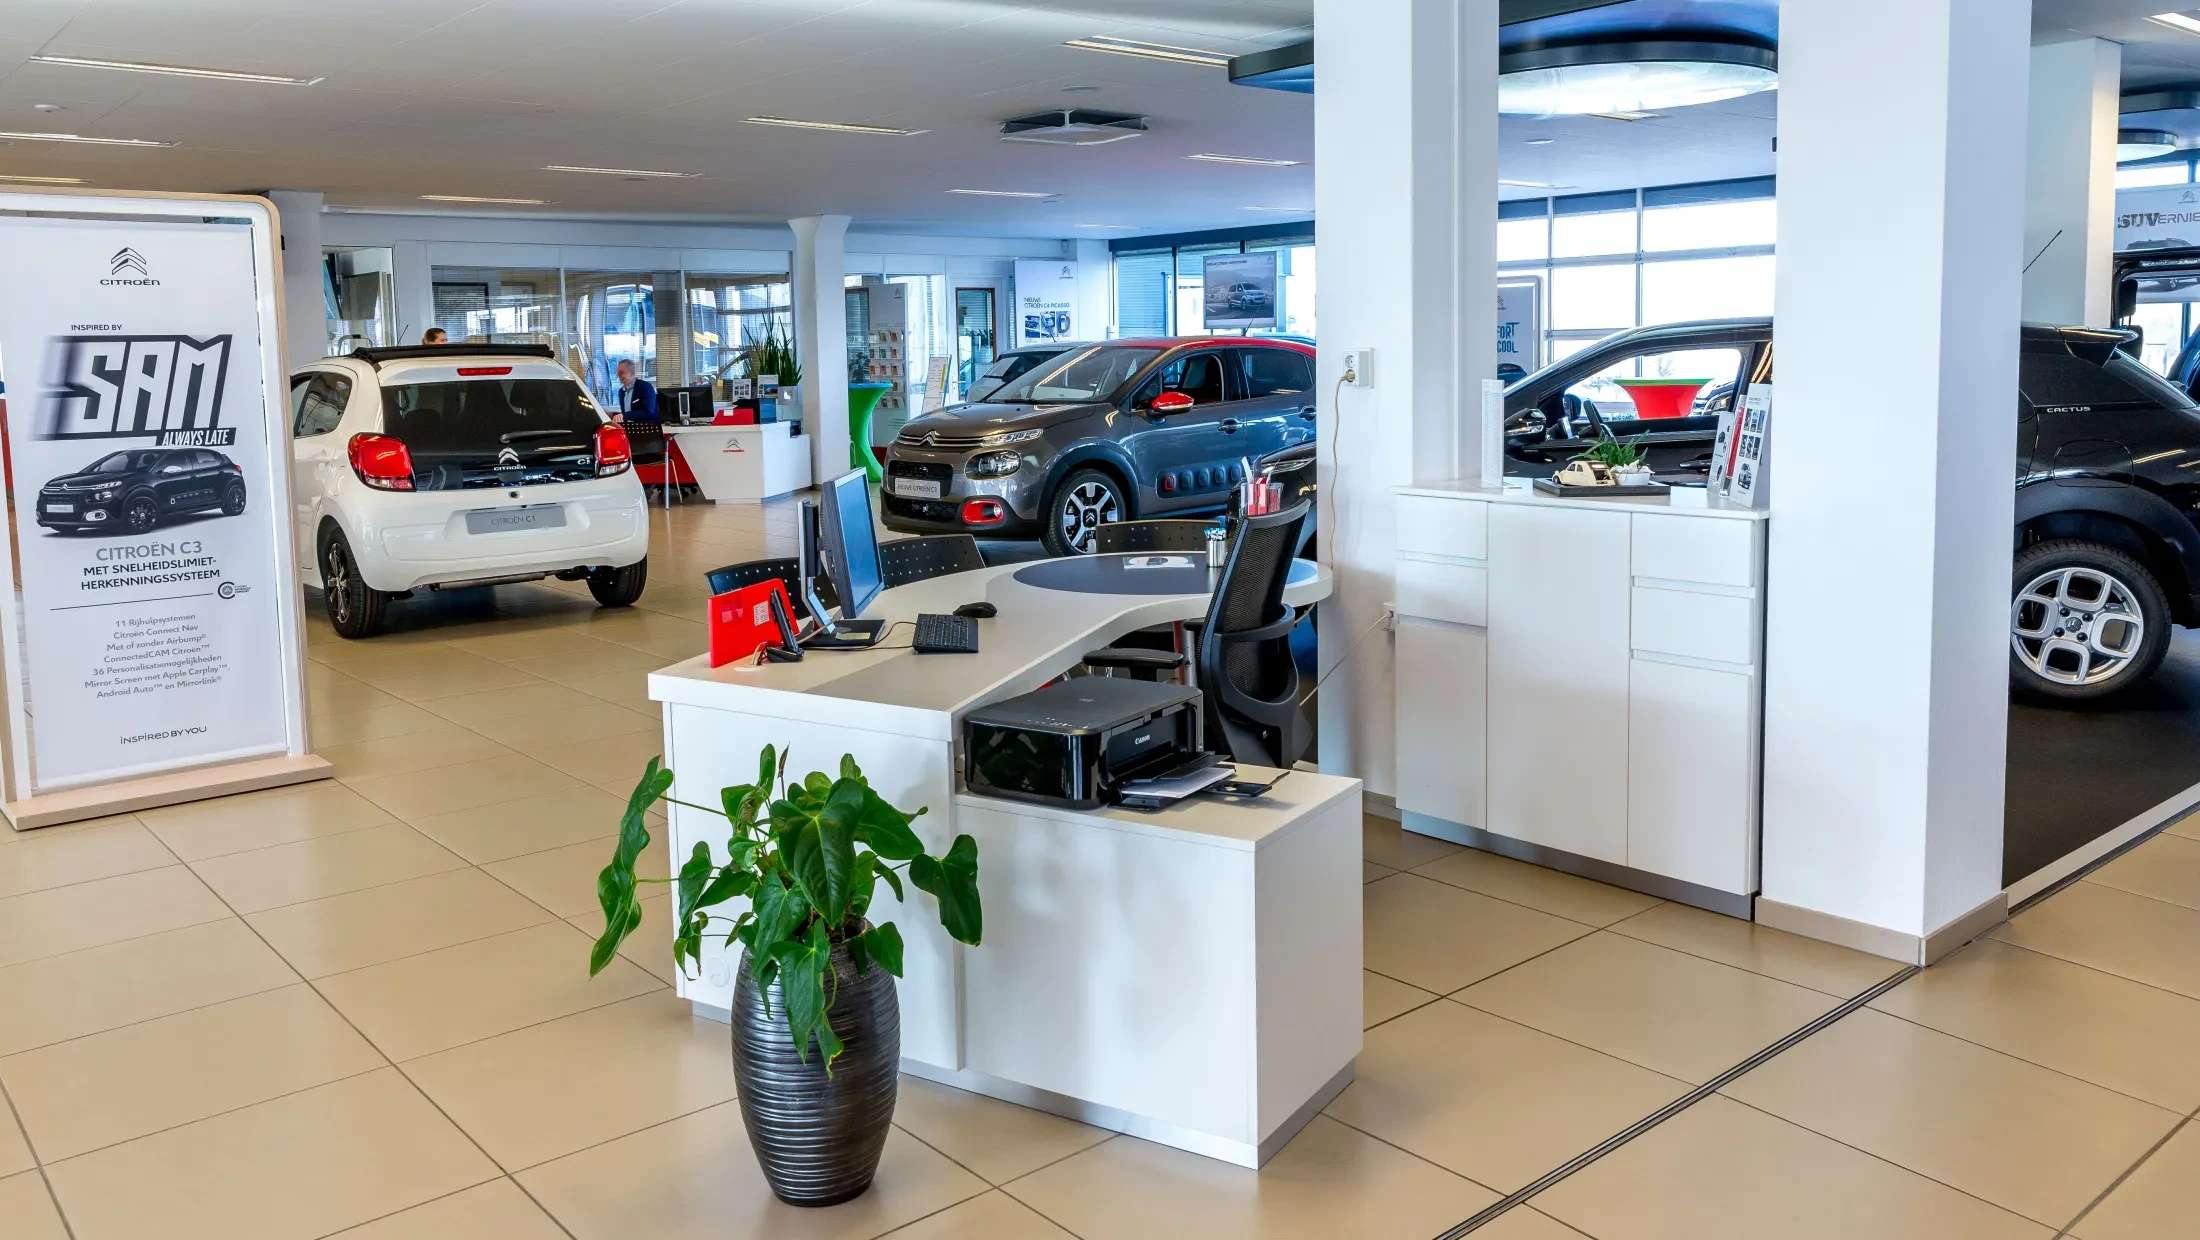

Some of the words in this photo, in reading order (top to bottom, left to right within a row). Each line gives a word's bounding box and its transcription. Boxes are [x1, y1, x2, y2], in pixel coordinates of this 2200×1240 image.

[1497, 340, 1519, 353] COOL
[46, 335, 232, 438] SAM
[162, 430, 204, 446] ALWAYS
[204, 429, 230, 445] LATE
[491, 514, 524, 526] CITROËN
[525, 515, 536, 523] C1
[96, 541, 175, 561] CITROËN
[180, 540, 203, 554] C3
[83, 565, 109, 577] MET
[112, 556, 217, 574] SNELHEIDSLIMIET-
[81, 569, 220, 590] HERKENNINGSSYSTEEM
[115, 620, 126, 628] 11
[128, 614, 196, 628] Rijhulpsystemen
[113, 630, 145, 640] Citroën
[146, 626, 180, 636] Connect
[182, 624, 199, 632] Nav
[106, 642, 124, 651] Met
[126, 640, 135, 650] of
[136, 638, 164, 648] zonder
[103, 649, 170, 663] ConnectedCAM
[84, 679, 112, 689] Mirror
[114, 675, 143, 685] Screen
[144, 673, 161, 681] met
[162, 669, 187, 681] Apple
[93, 668, 105, 676] 36
[96, 688, 131, 699] Android
[170, 728, 184, 738] BY
[184, 726, 207, 735] YOU
[1134, 734, 1151, 745] Canon
